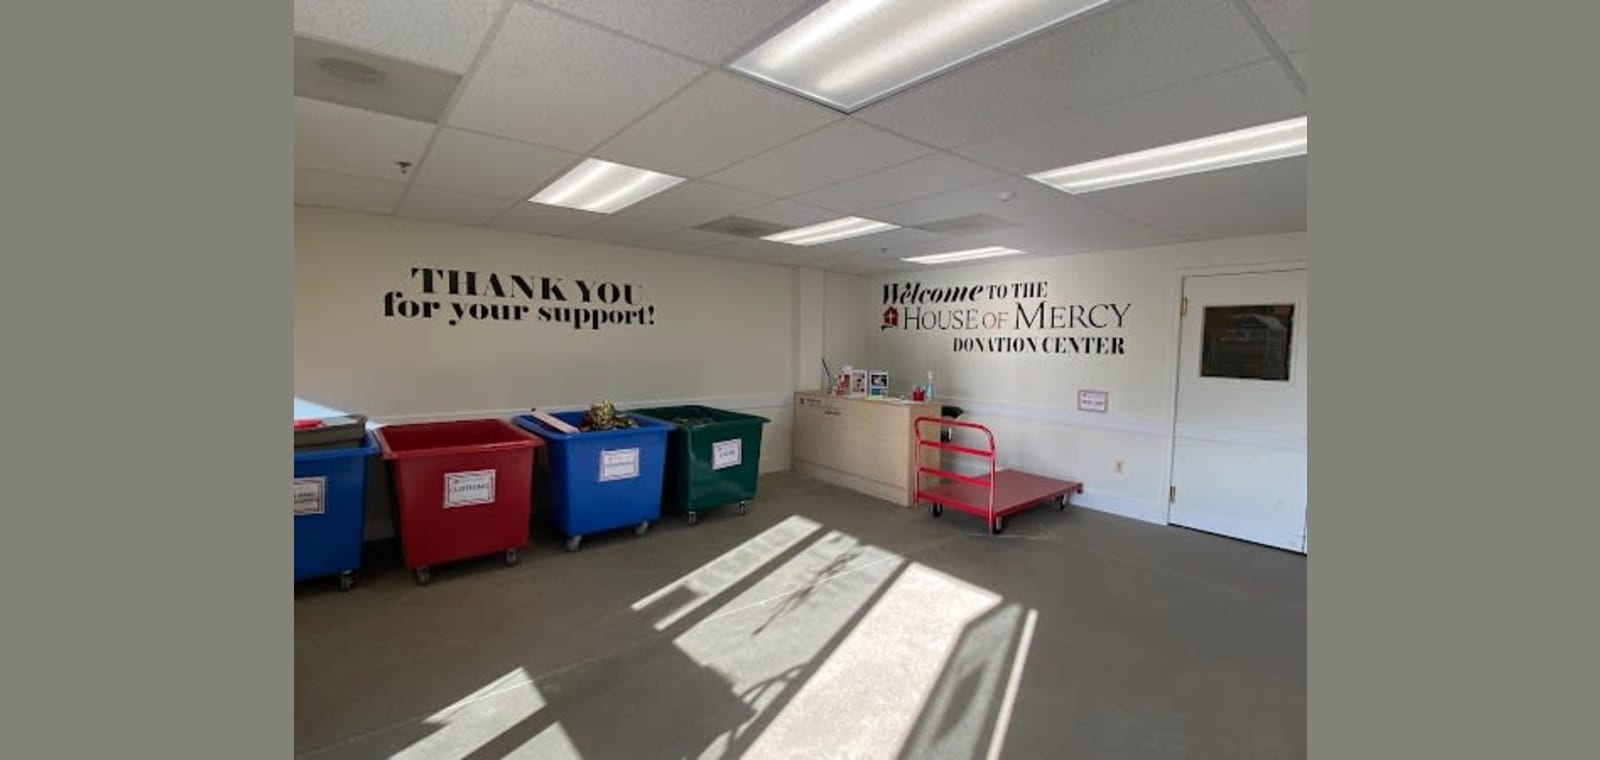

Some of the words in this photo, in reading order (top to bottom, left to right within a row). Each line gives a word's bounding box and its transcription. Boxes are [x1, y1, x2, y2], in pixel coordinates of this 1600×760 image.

[411, 267, 567, 301] THANK
[575, 279, 644, 306] YOU
[881, 281, 984, 305] Welcome
[985, 284, 1008, 300] TO
[1011, 281, 1048, 299] THE
[384, 290, 441, 319] for
[448, 302, 530, 326] your
[538, 305, 655, 330] support!
[903, 306, 979, 330] HOUSE
[981, 311, 1009, 330] OF
[1014, 301, 1132, 330] MERCY
[953, 336, 1039, 353] DONATION
[1042, 336, 1125, 355] CENTER
